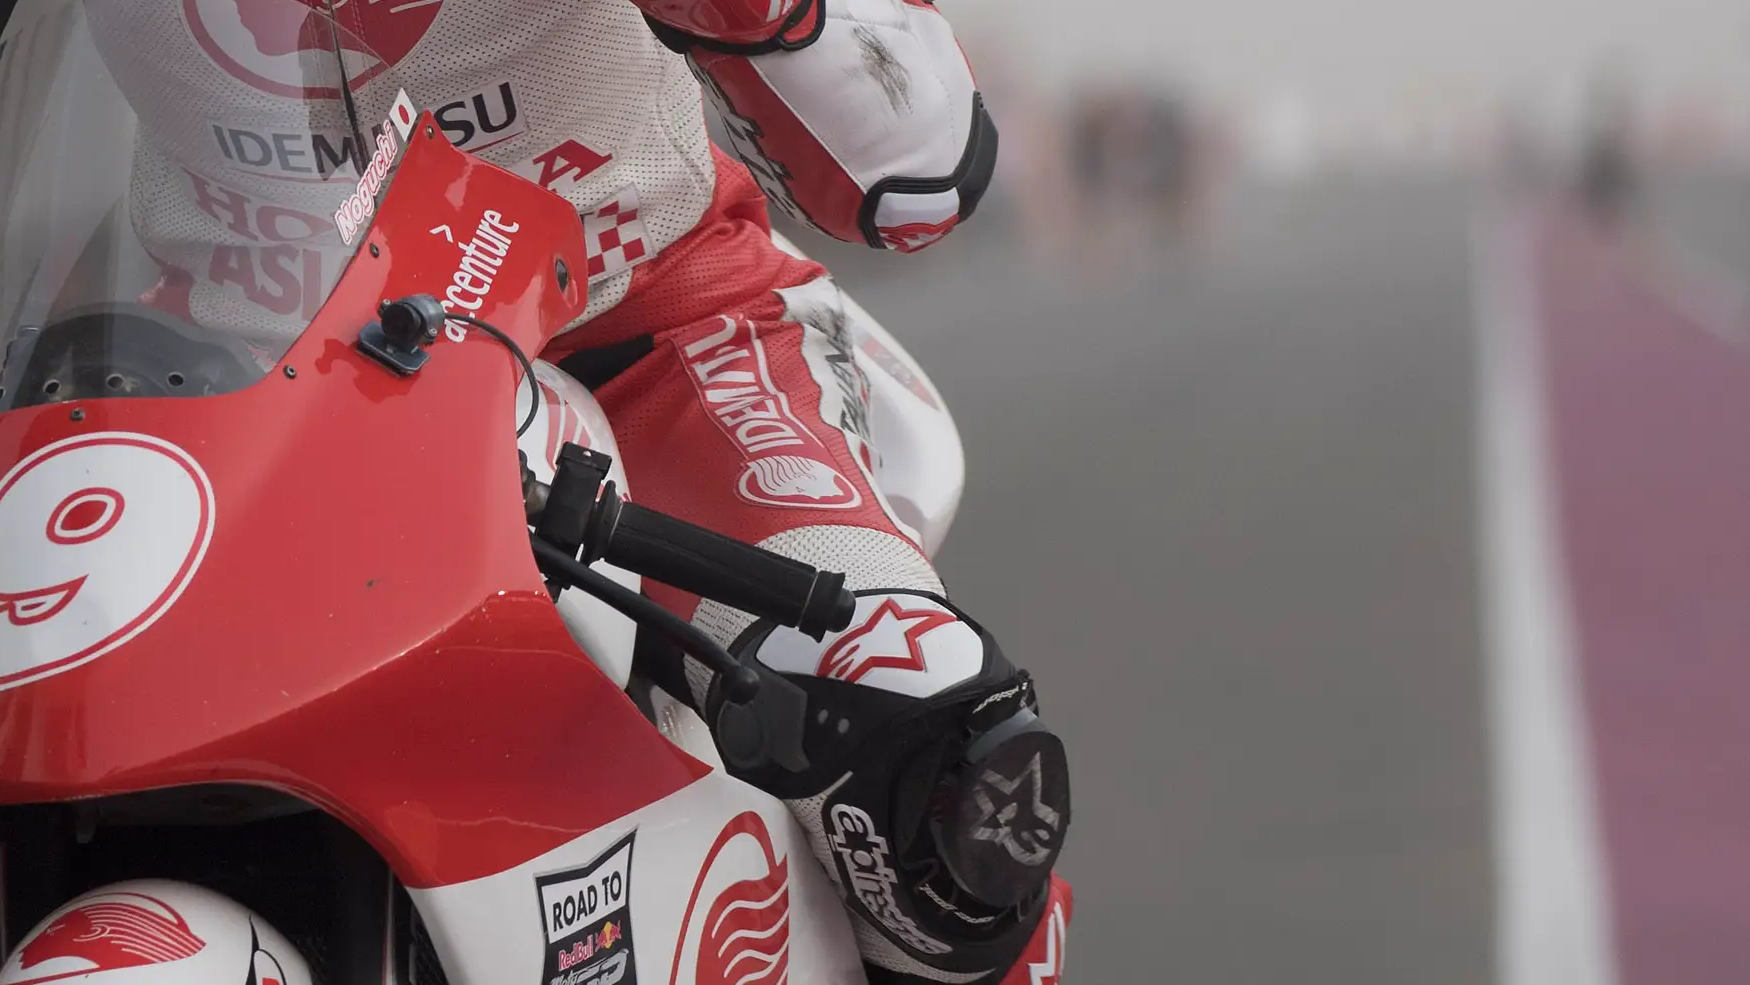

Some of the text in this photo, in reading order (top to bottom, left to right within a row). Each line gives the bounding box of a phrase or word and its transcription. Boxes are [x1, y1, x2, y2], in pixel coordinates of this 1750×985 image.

[212, 81, 519, 181] IDEMSU
[335, 119, 398, 246] Noguchi
[208, 243, 353, 322] ASI
[684, 314, 805, 453] IDEMITU
[552, 871, 622, 933] ROAD TO
